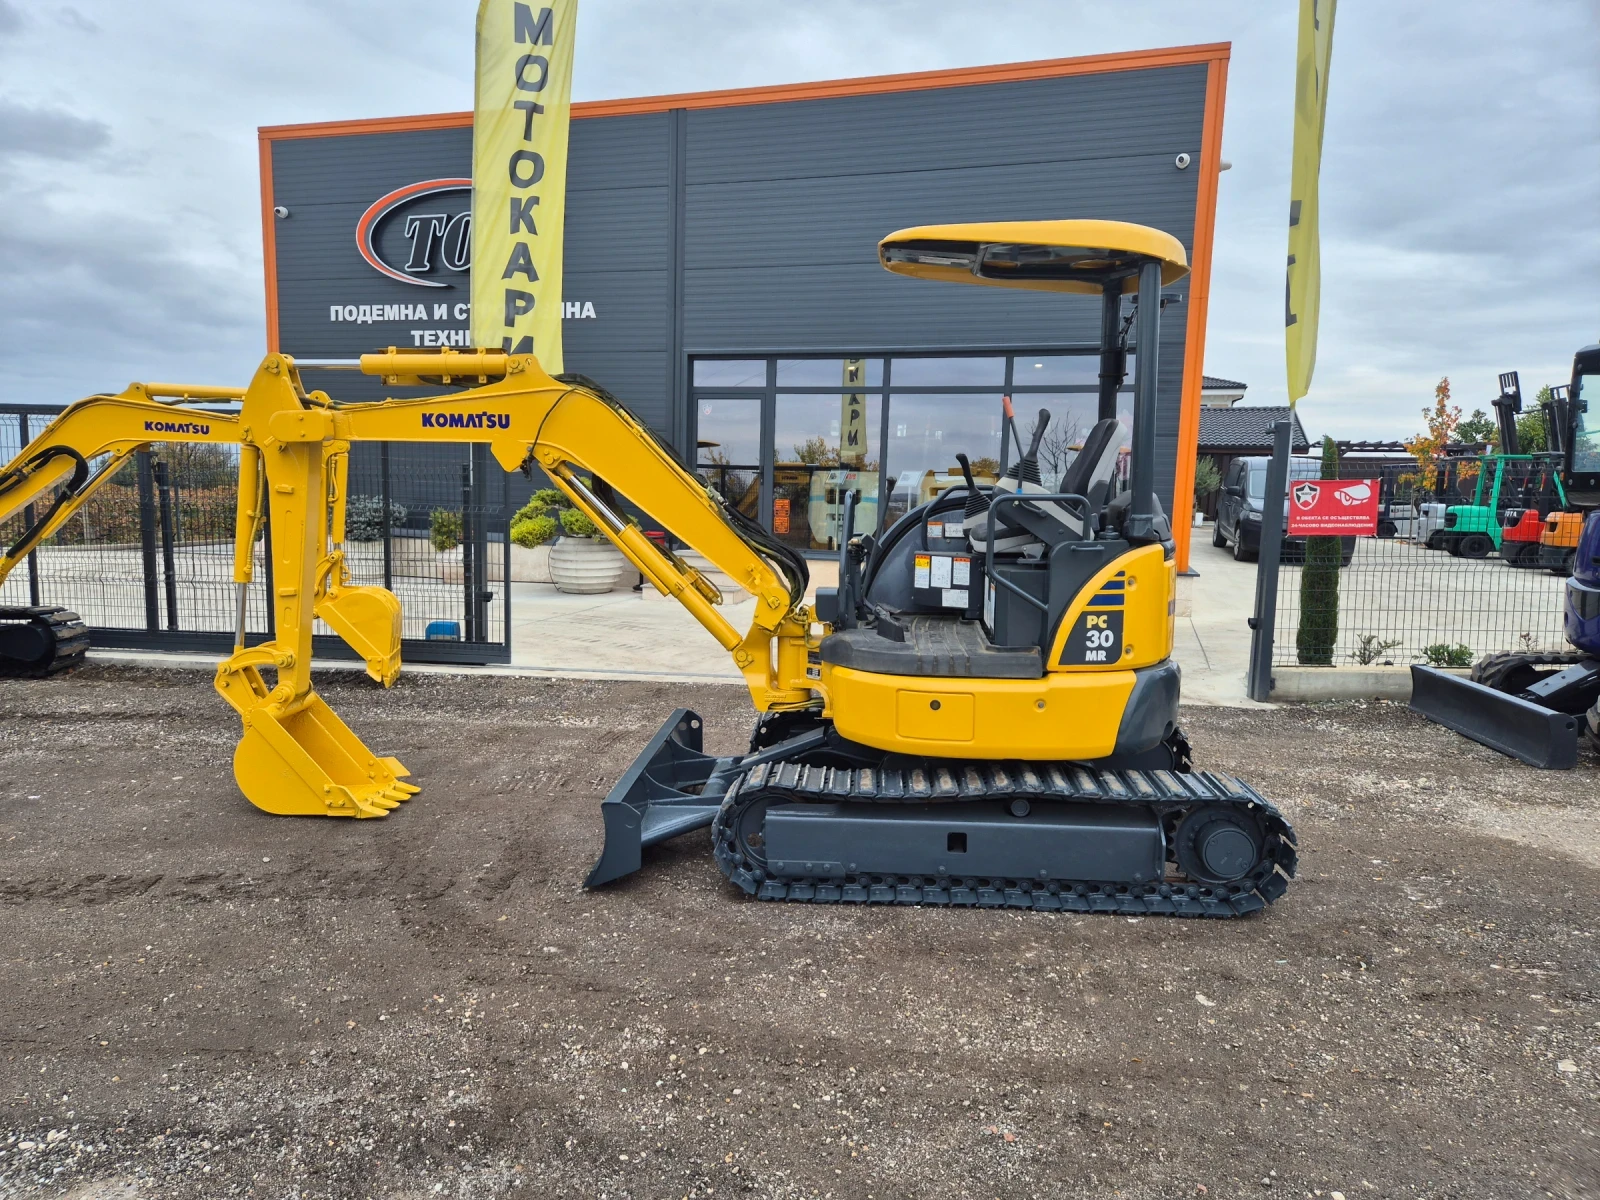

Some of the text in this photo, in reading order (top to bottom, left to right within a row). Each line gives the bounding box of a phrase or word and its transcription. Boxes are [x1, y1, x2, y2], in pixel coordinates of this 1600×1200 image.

[501, 1, 554, 355] МОТОКАРИ
[404, 211, 471, 272] TO
[330, 304, 428, 324] ПОДЕМНА
[433, 303, 447, 320] И
[144, 421, 210, 435] KOMATSU
[421, 411, 510, 429] KOMATSU
[1086, 615, 1107, 628] PC
[1085, 630, 1114, 648] 30
[1085, 650, 1106, 661] MR
